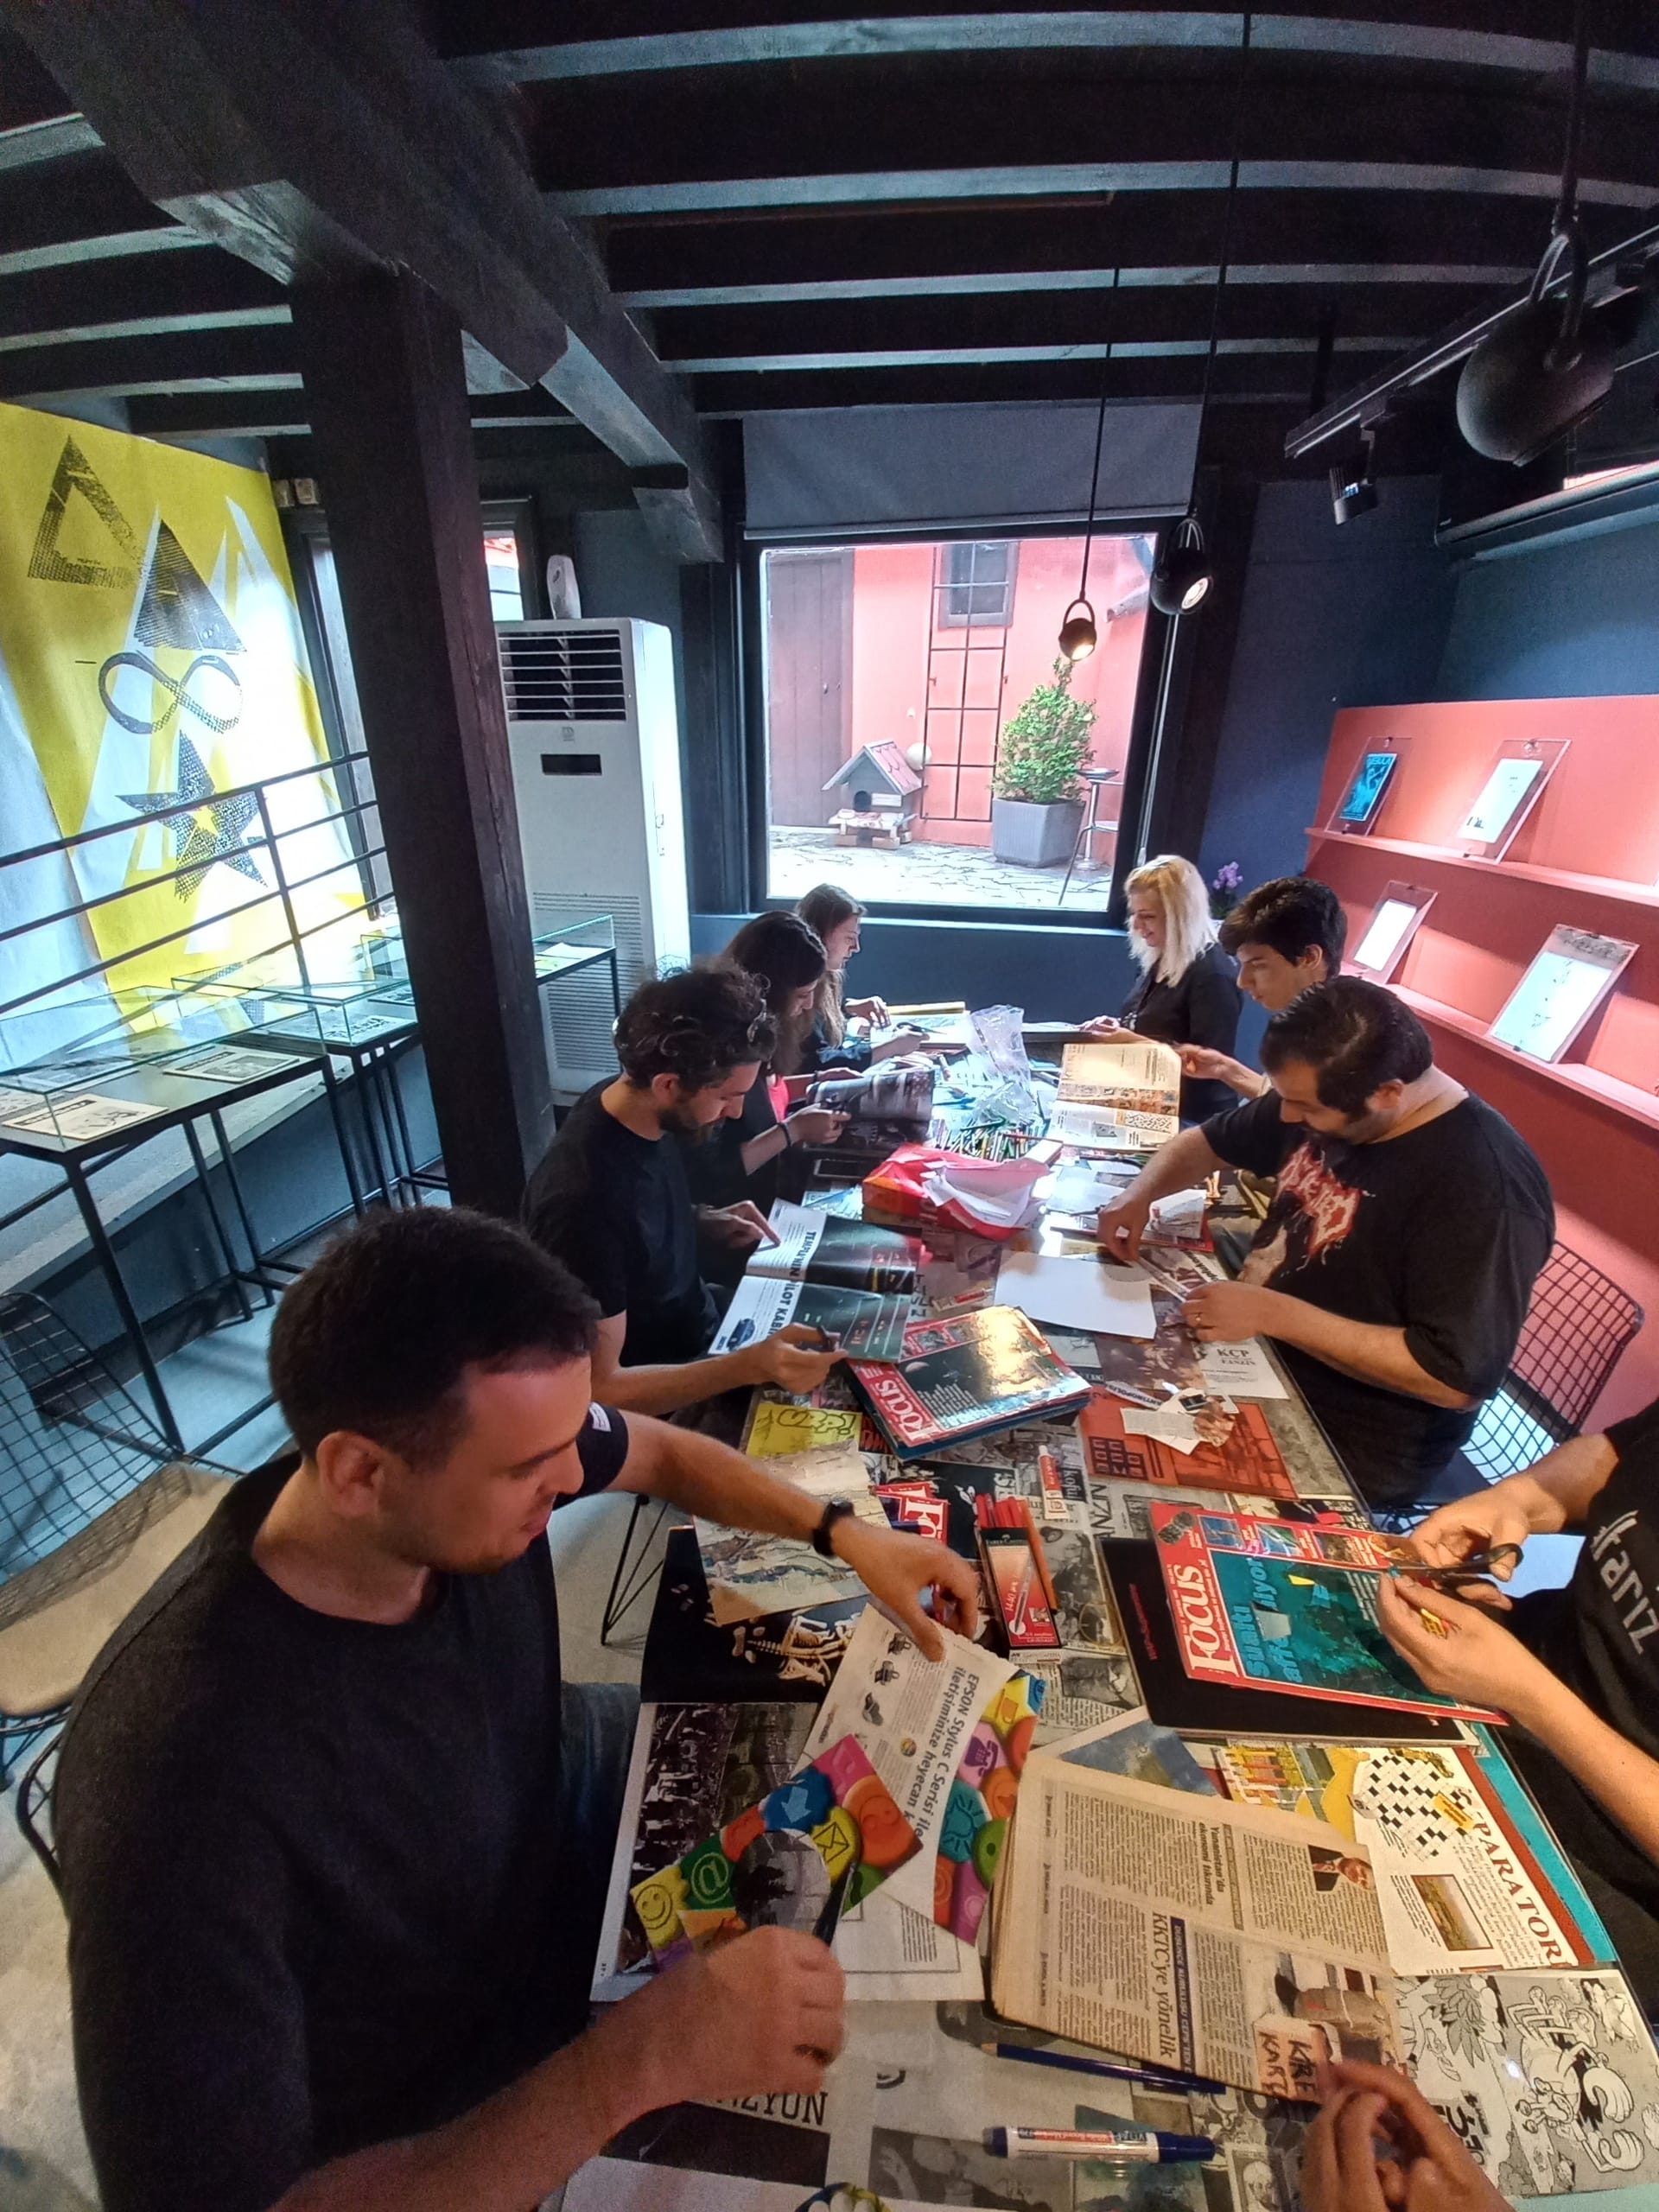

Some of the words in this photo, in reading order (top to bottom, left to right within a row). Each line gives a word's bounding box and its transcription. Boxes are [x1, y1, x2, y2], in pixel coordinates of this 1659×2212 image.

[961, 1673, 981, 1714] EPSON
[943, 1714, 965, 1764] Stylus
[907, 1751, 937, 1809] heyecan
[926, 1776, 949, 1813] Serisi
[1471, 1814, 1578, 1967] PARATOR
[1151, 1913, 1168, 1984] KKTC'ye
[1154, 1985, 1174, 2058] yönelik
